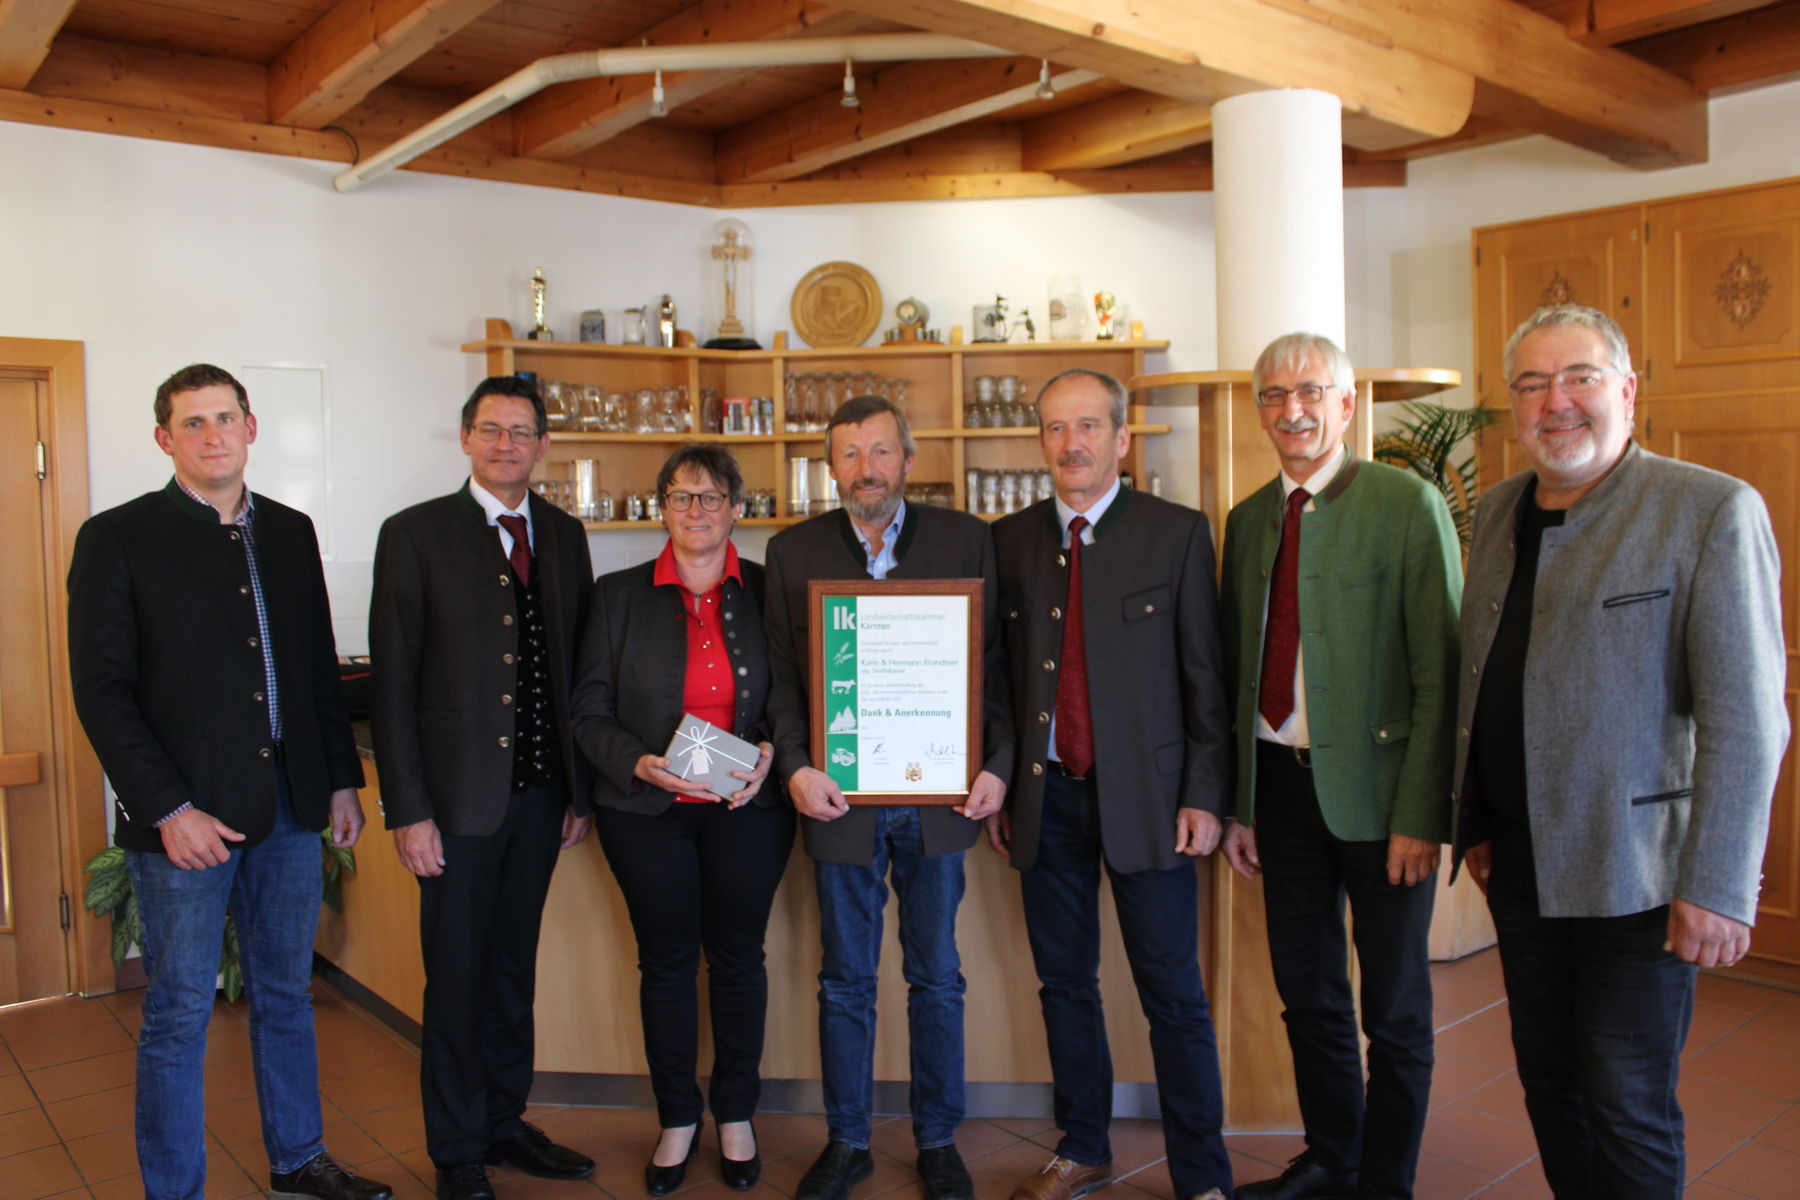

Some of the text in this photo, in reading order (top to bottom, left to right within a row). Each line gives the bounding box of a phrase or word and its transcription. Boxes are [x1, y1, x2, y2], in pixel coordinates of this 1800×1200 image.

[861, 708, 951, 718] Dank & Anerkennung
